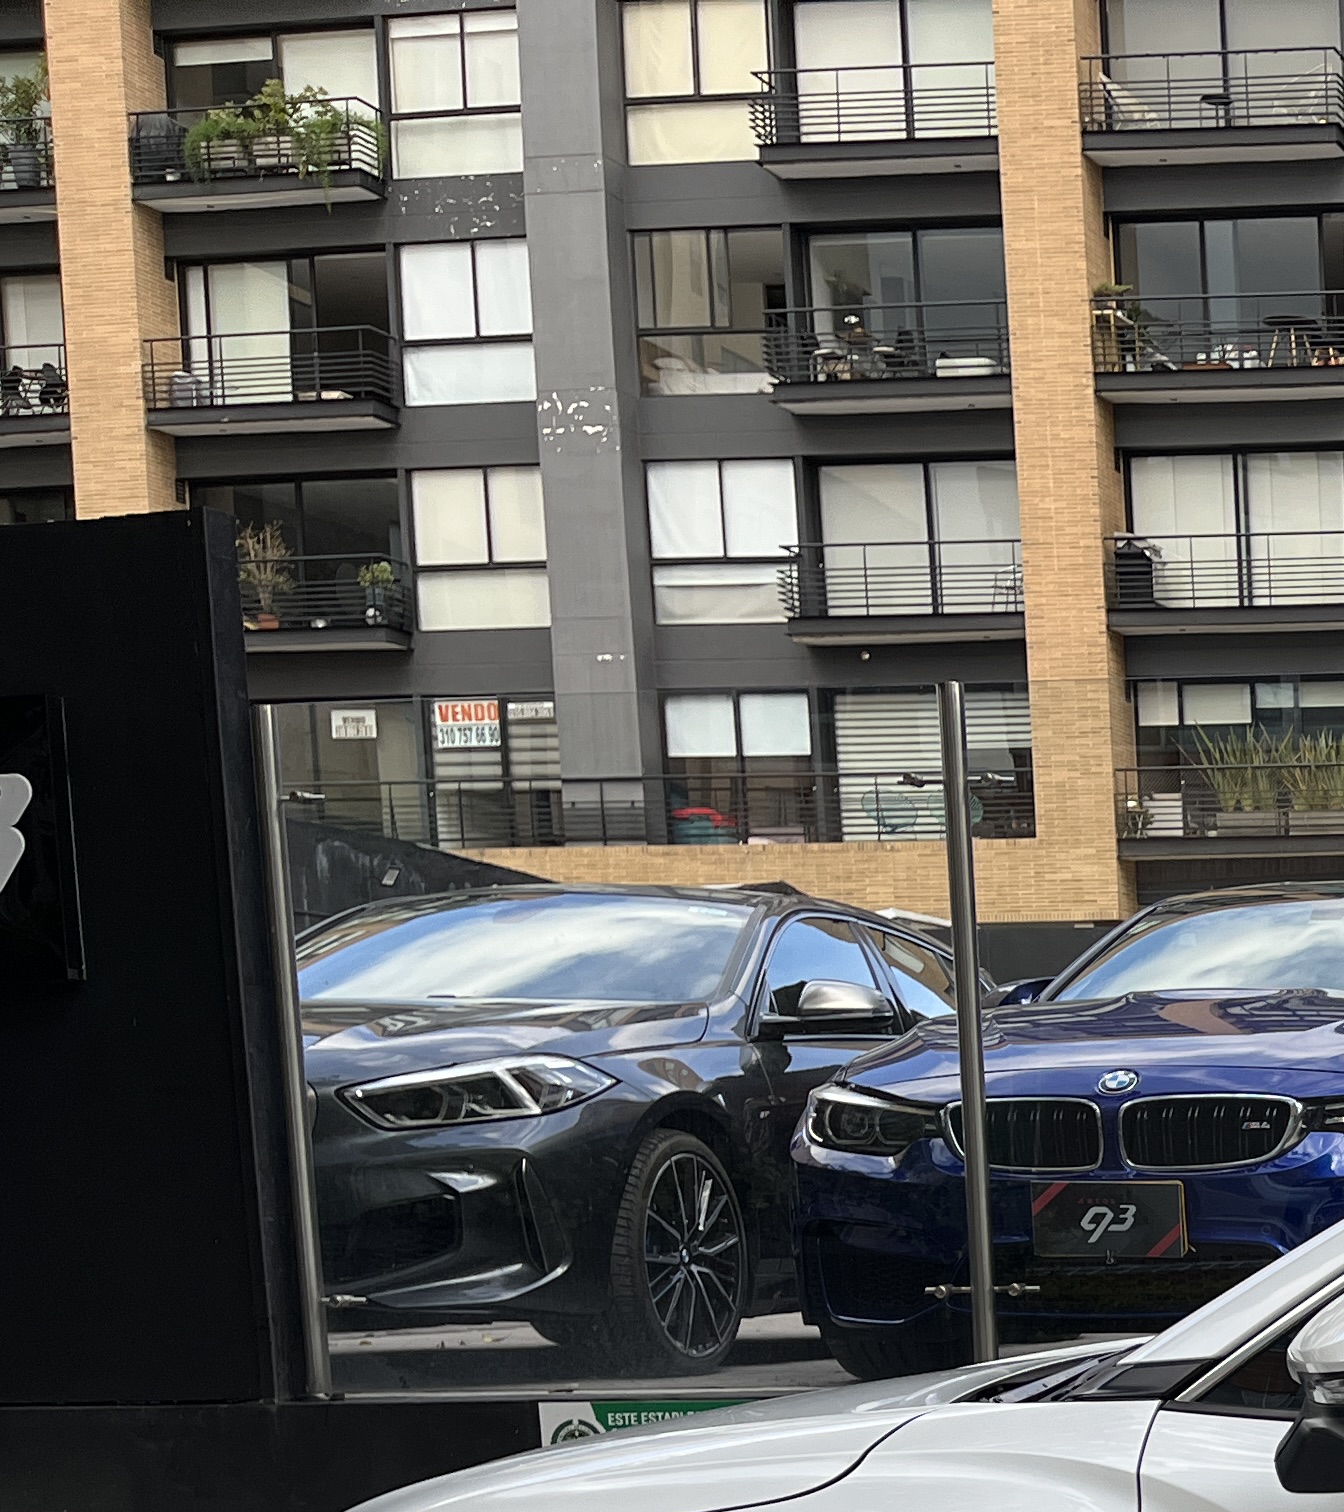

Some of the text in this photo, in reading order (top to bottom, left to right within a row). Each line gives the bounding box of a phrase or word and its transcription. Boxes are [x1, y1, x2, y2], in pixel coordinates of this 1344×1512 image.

[438, 702, 499, 723] VENDO
[440, 727, 456, 744] 310
[607, 1412, 638, 1426] ESTE
